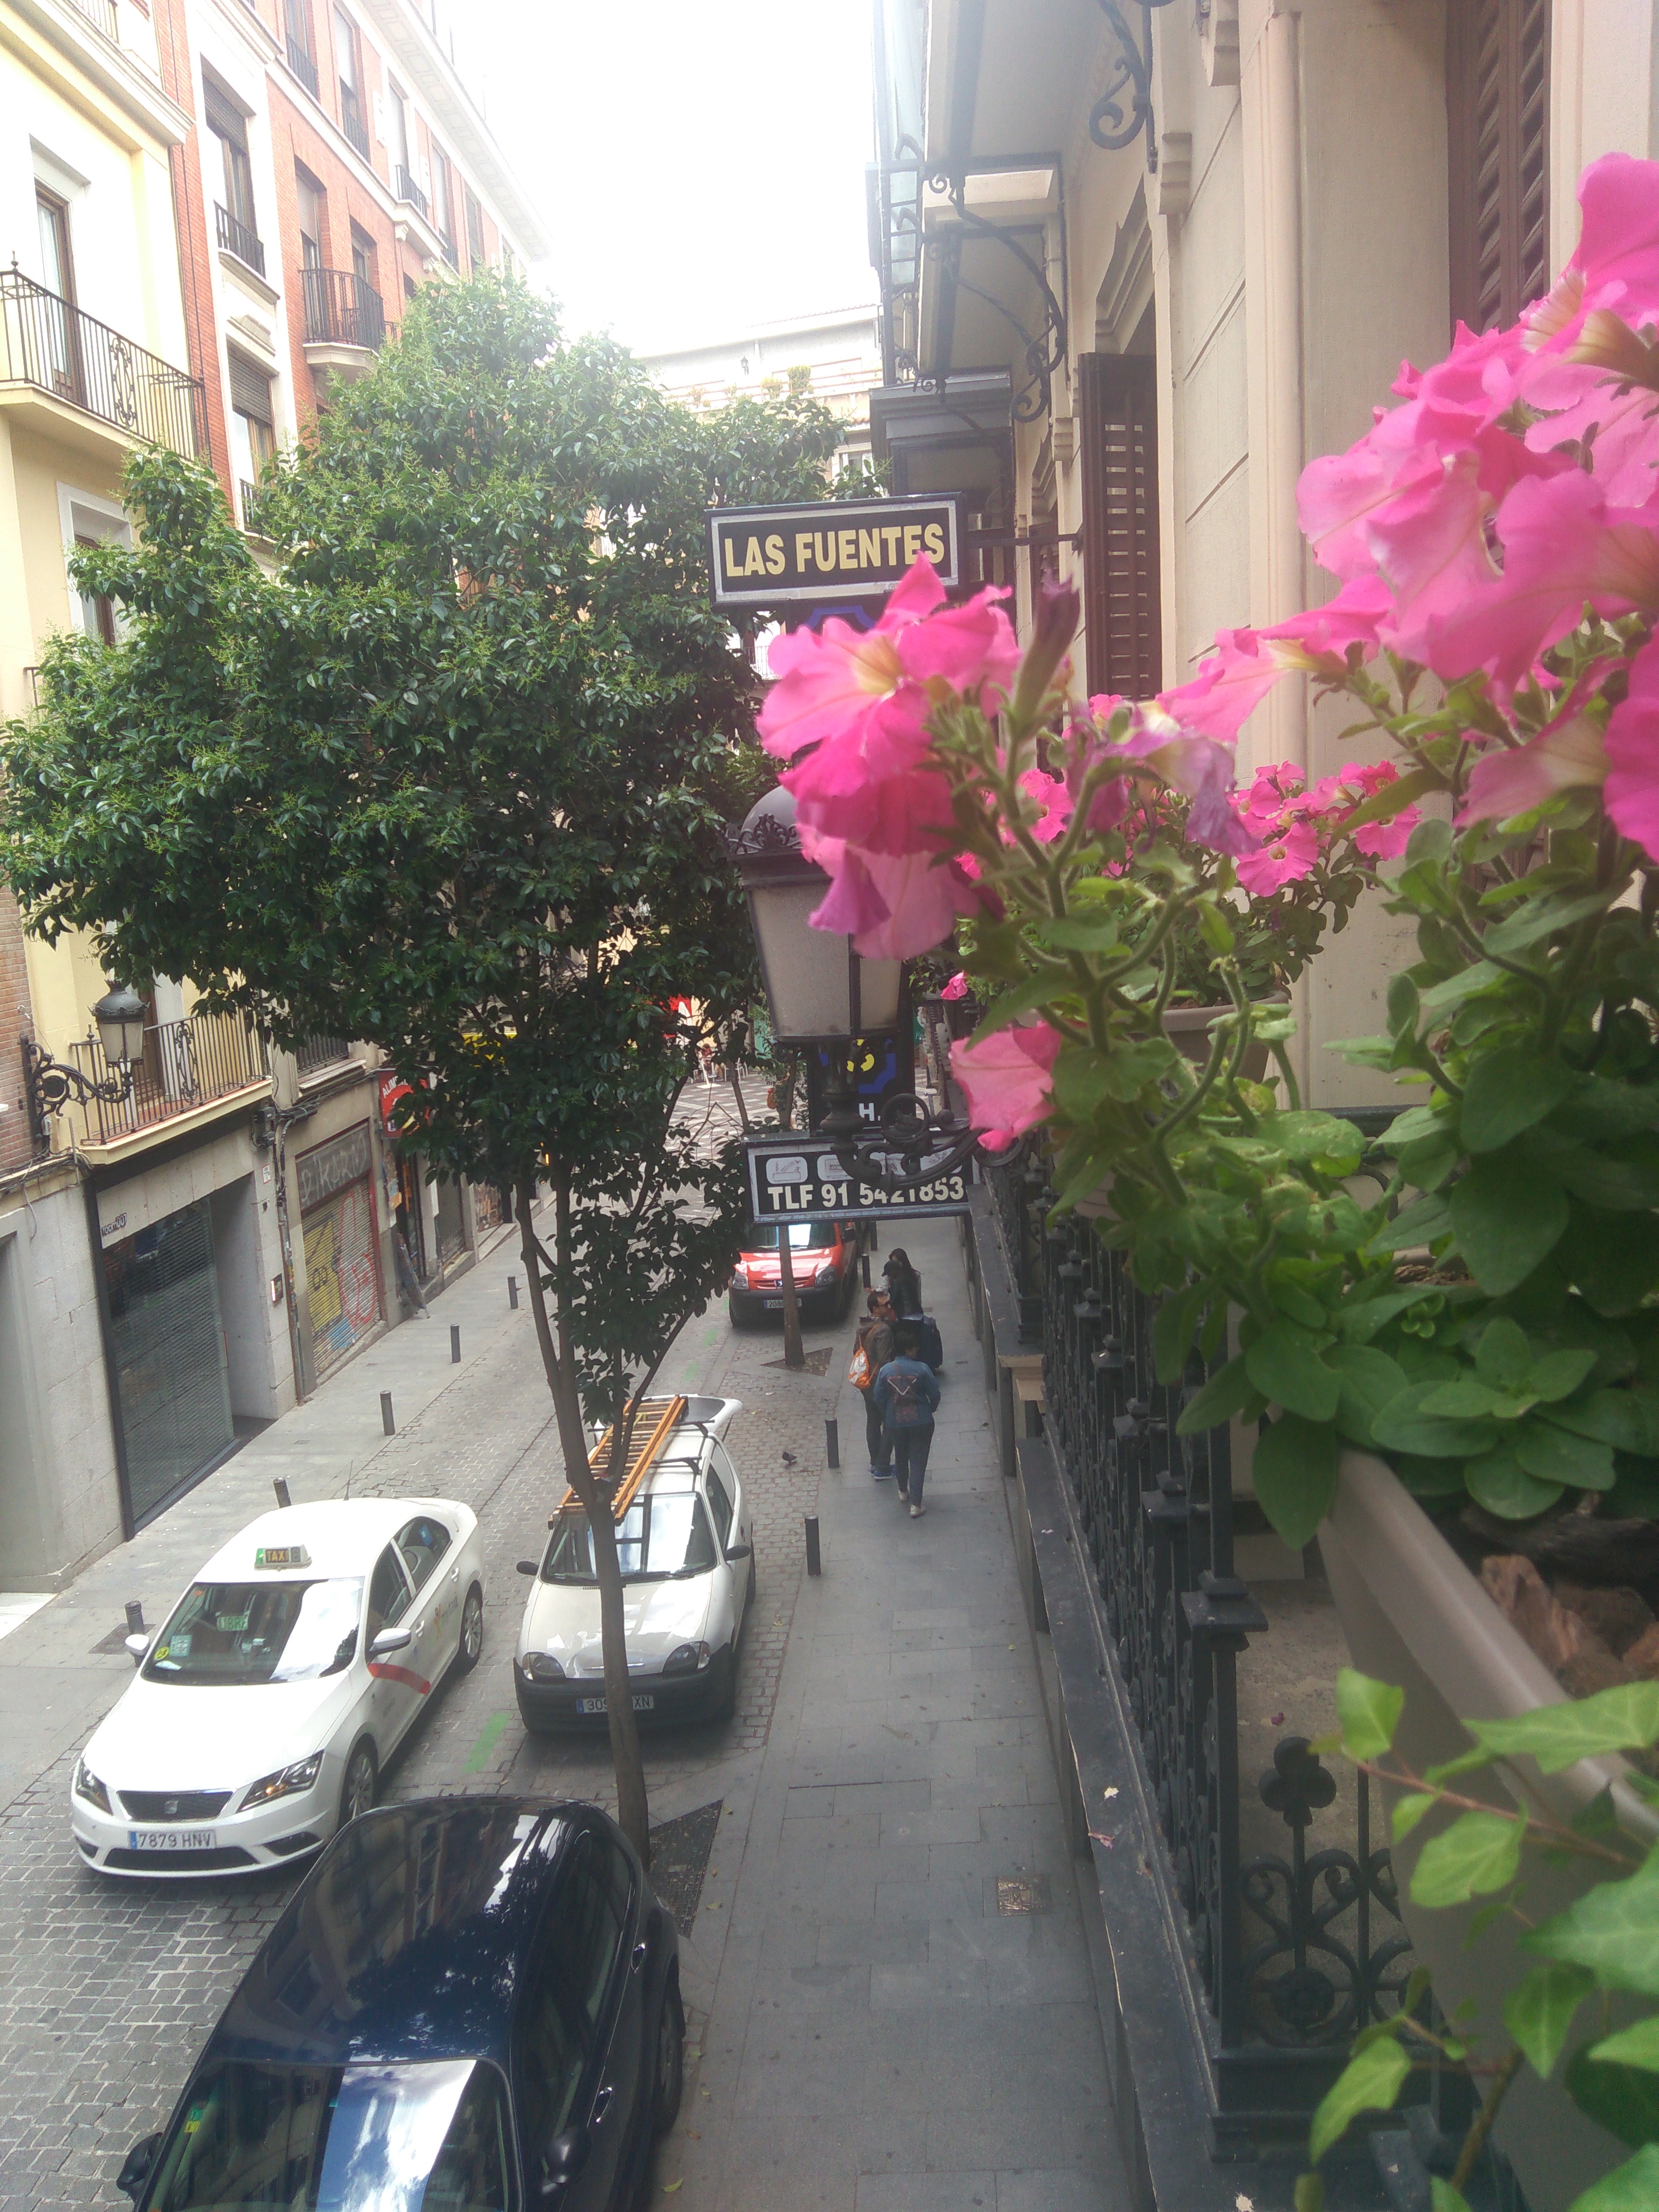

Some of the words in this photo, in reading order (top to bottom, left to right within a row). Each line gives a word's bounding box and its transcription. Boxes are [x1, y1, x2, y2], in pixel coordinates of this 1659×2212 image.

[724, 534, 786, 577] LAS
[795, 523, 945, 573] FUENTES
[767, 1184, 814, 1210] TLF
[821, 1182, 849, 1208] 91
[102, 1213, 127, 1235] room007
[266, 1549, 288, 1562] TAXI
[138, 1833, 177, 1848] 7879
[182, 1833, 211, 1848] HNV
